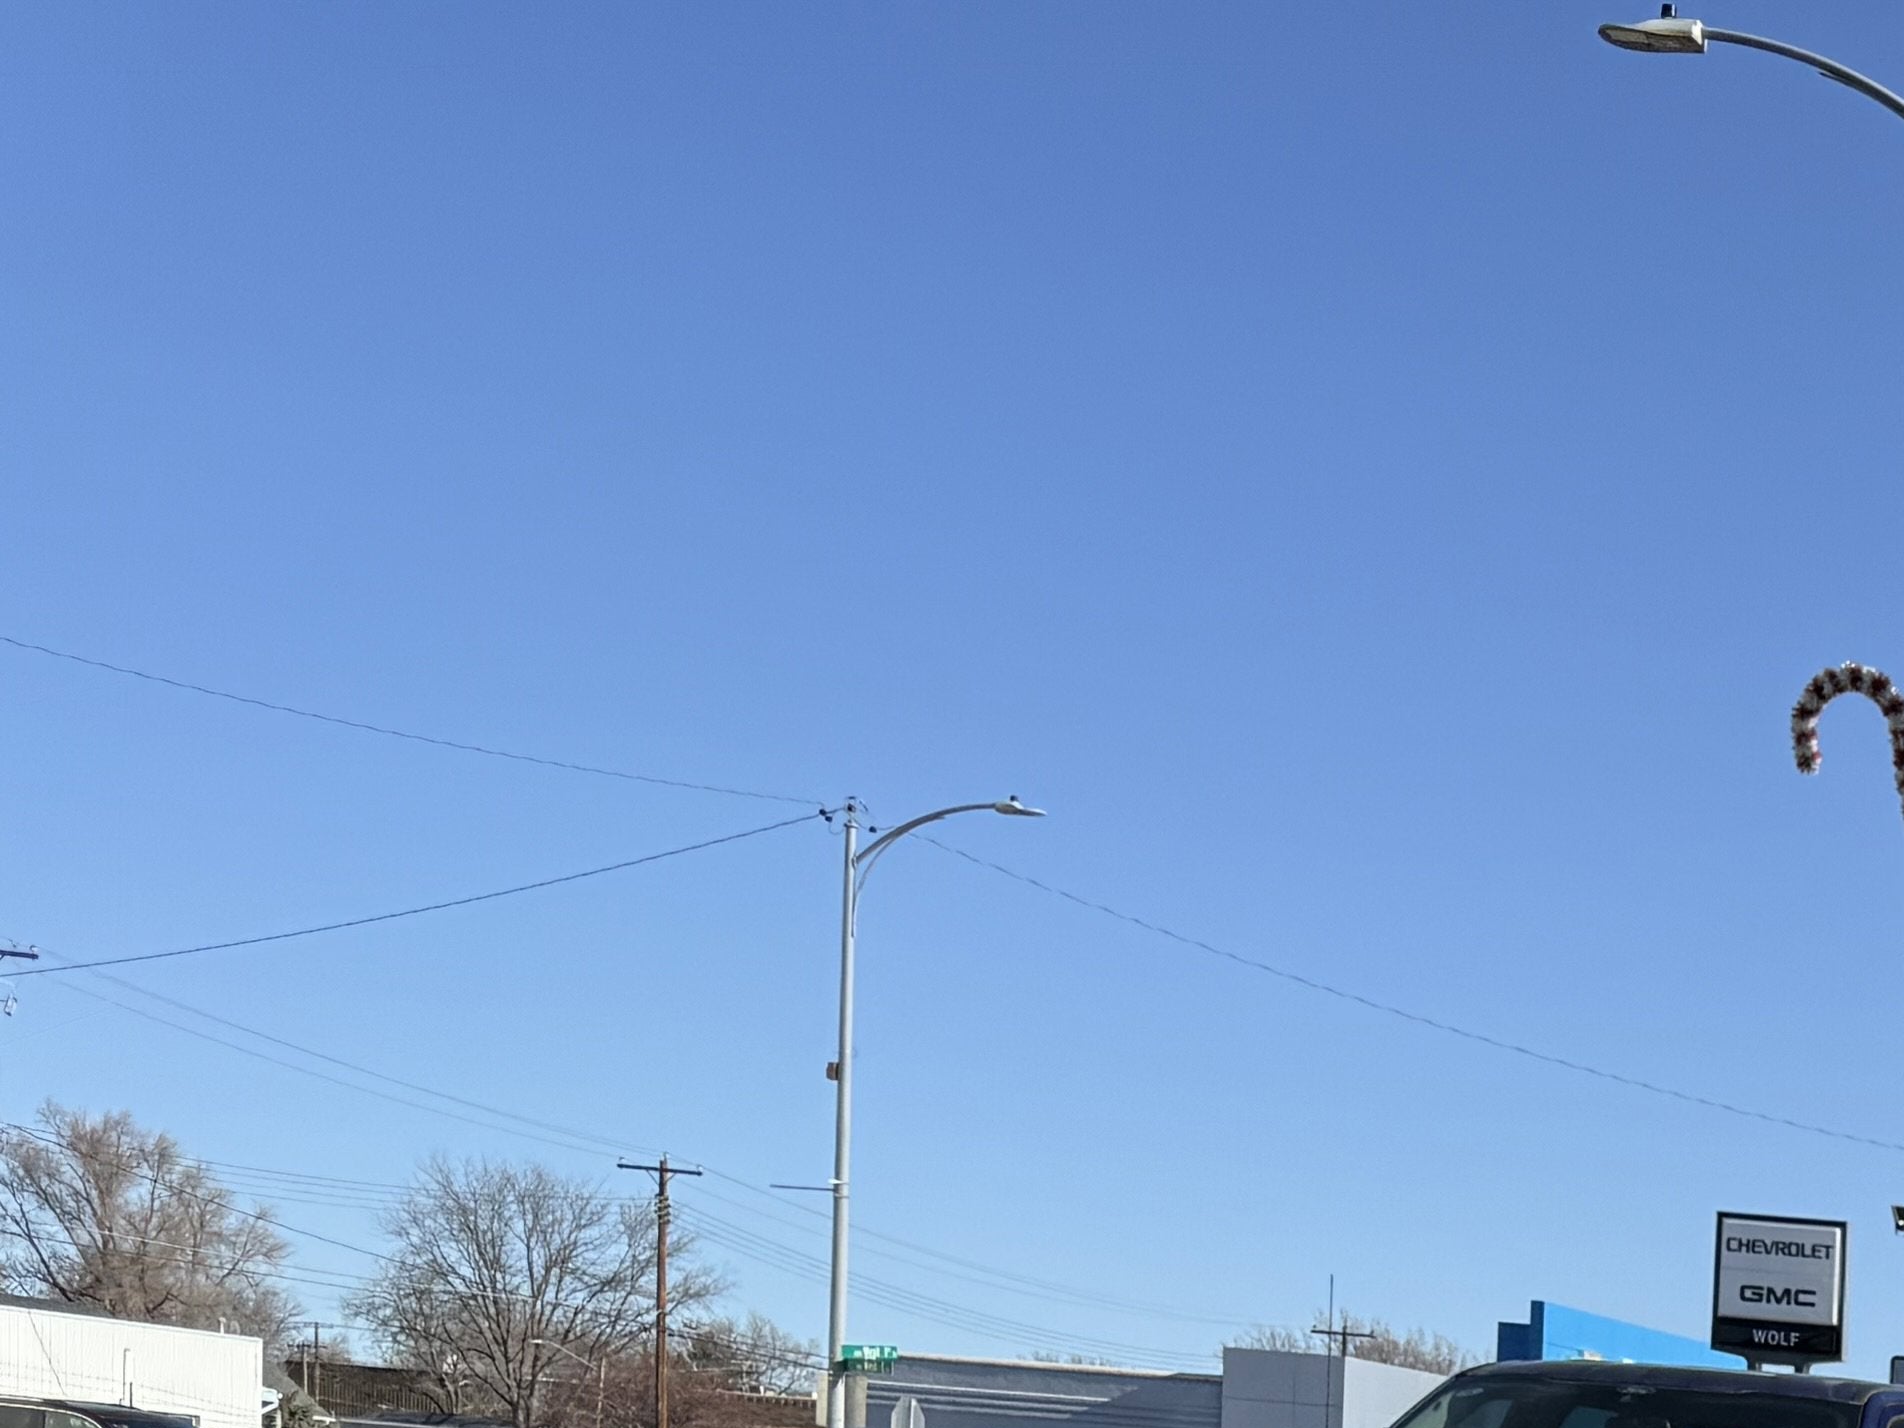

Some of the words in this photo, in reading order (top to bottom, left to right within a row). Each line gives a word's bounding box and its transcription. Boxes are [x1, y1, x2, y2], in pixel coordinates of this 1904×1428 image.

[1725, 1236, 1834, 1261] CHEVROLET
[1739, 1284, 1817, 1308] GMC
[1752, 1328, 1801, 1347] WOLF
